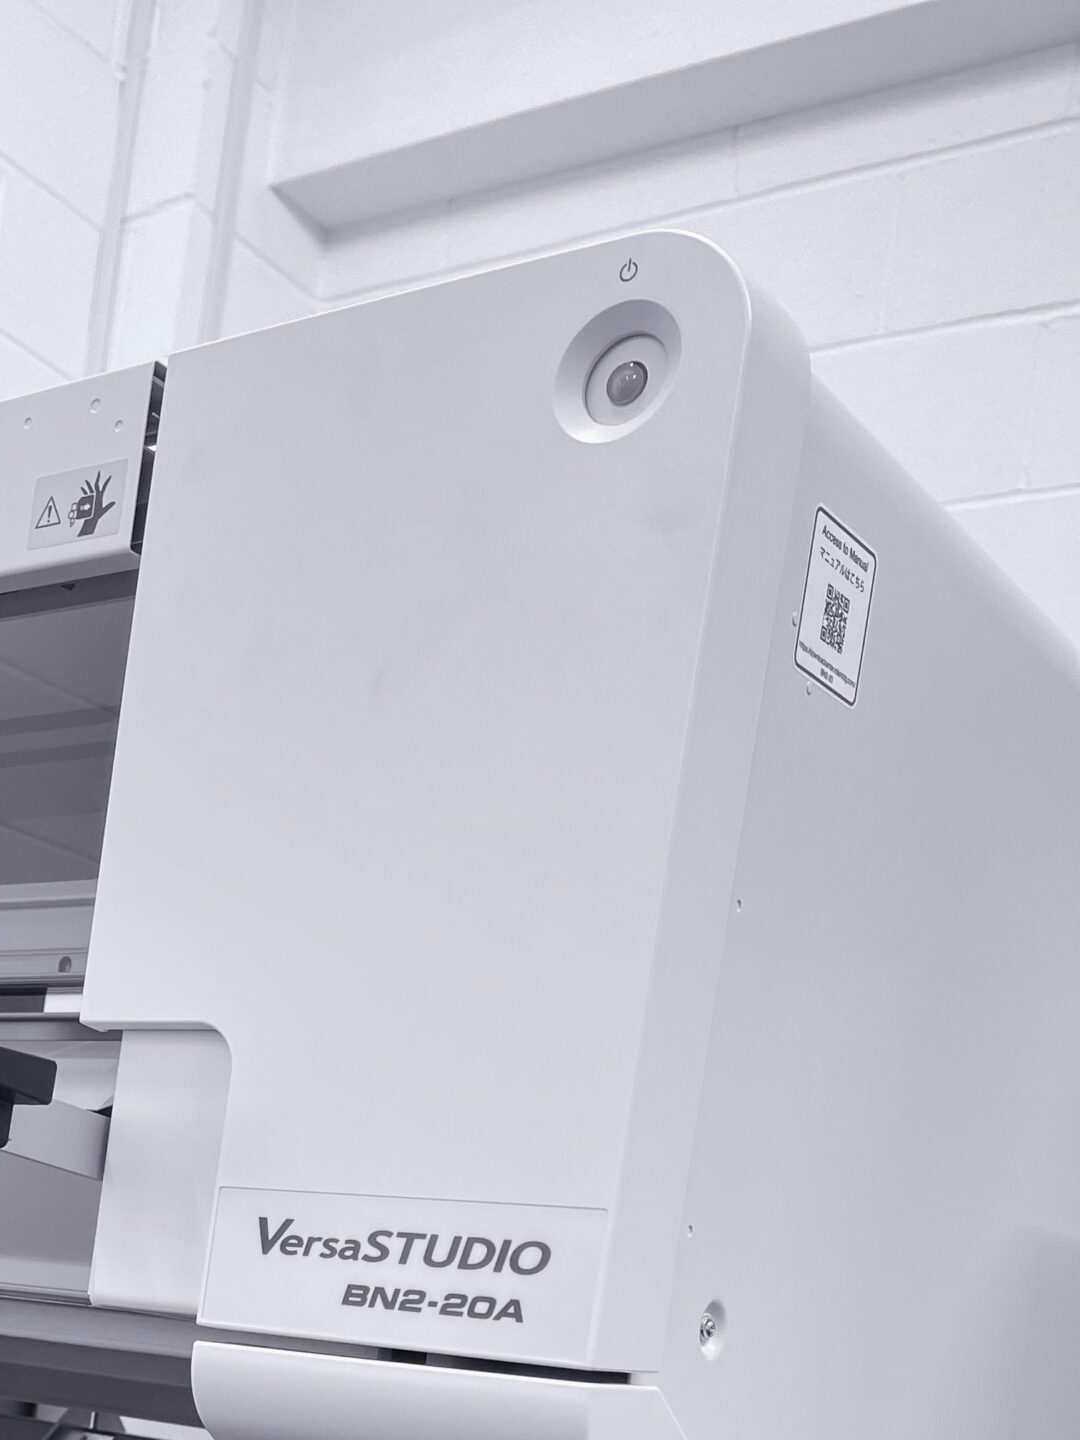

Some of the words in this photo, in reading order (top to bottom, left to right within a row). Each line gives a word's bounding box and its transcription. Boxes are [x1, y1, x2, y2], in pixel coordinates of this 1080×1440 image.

[820, 546, 864, 592] マニュアルはこちら
[822, 525, 842, 550] Access
[843, 542, 849, 555] to
[849, 547, 869, 572] Manual
[258, 1216, 552, 1276] VersaSTUDIO
[341, 1283, 524, 1324] BN2-20A
